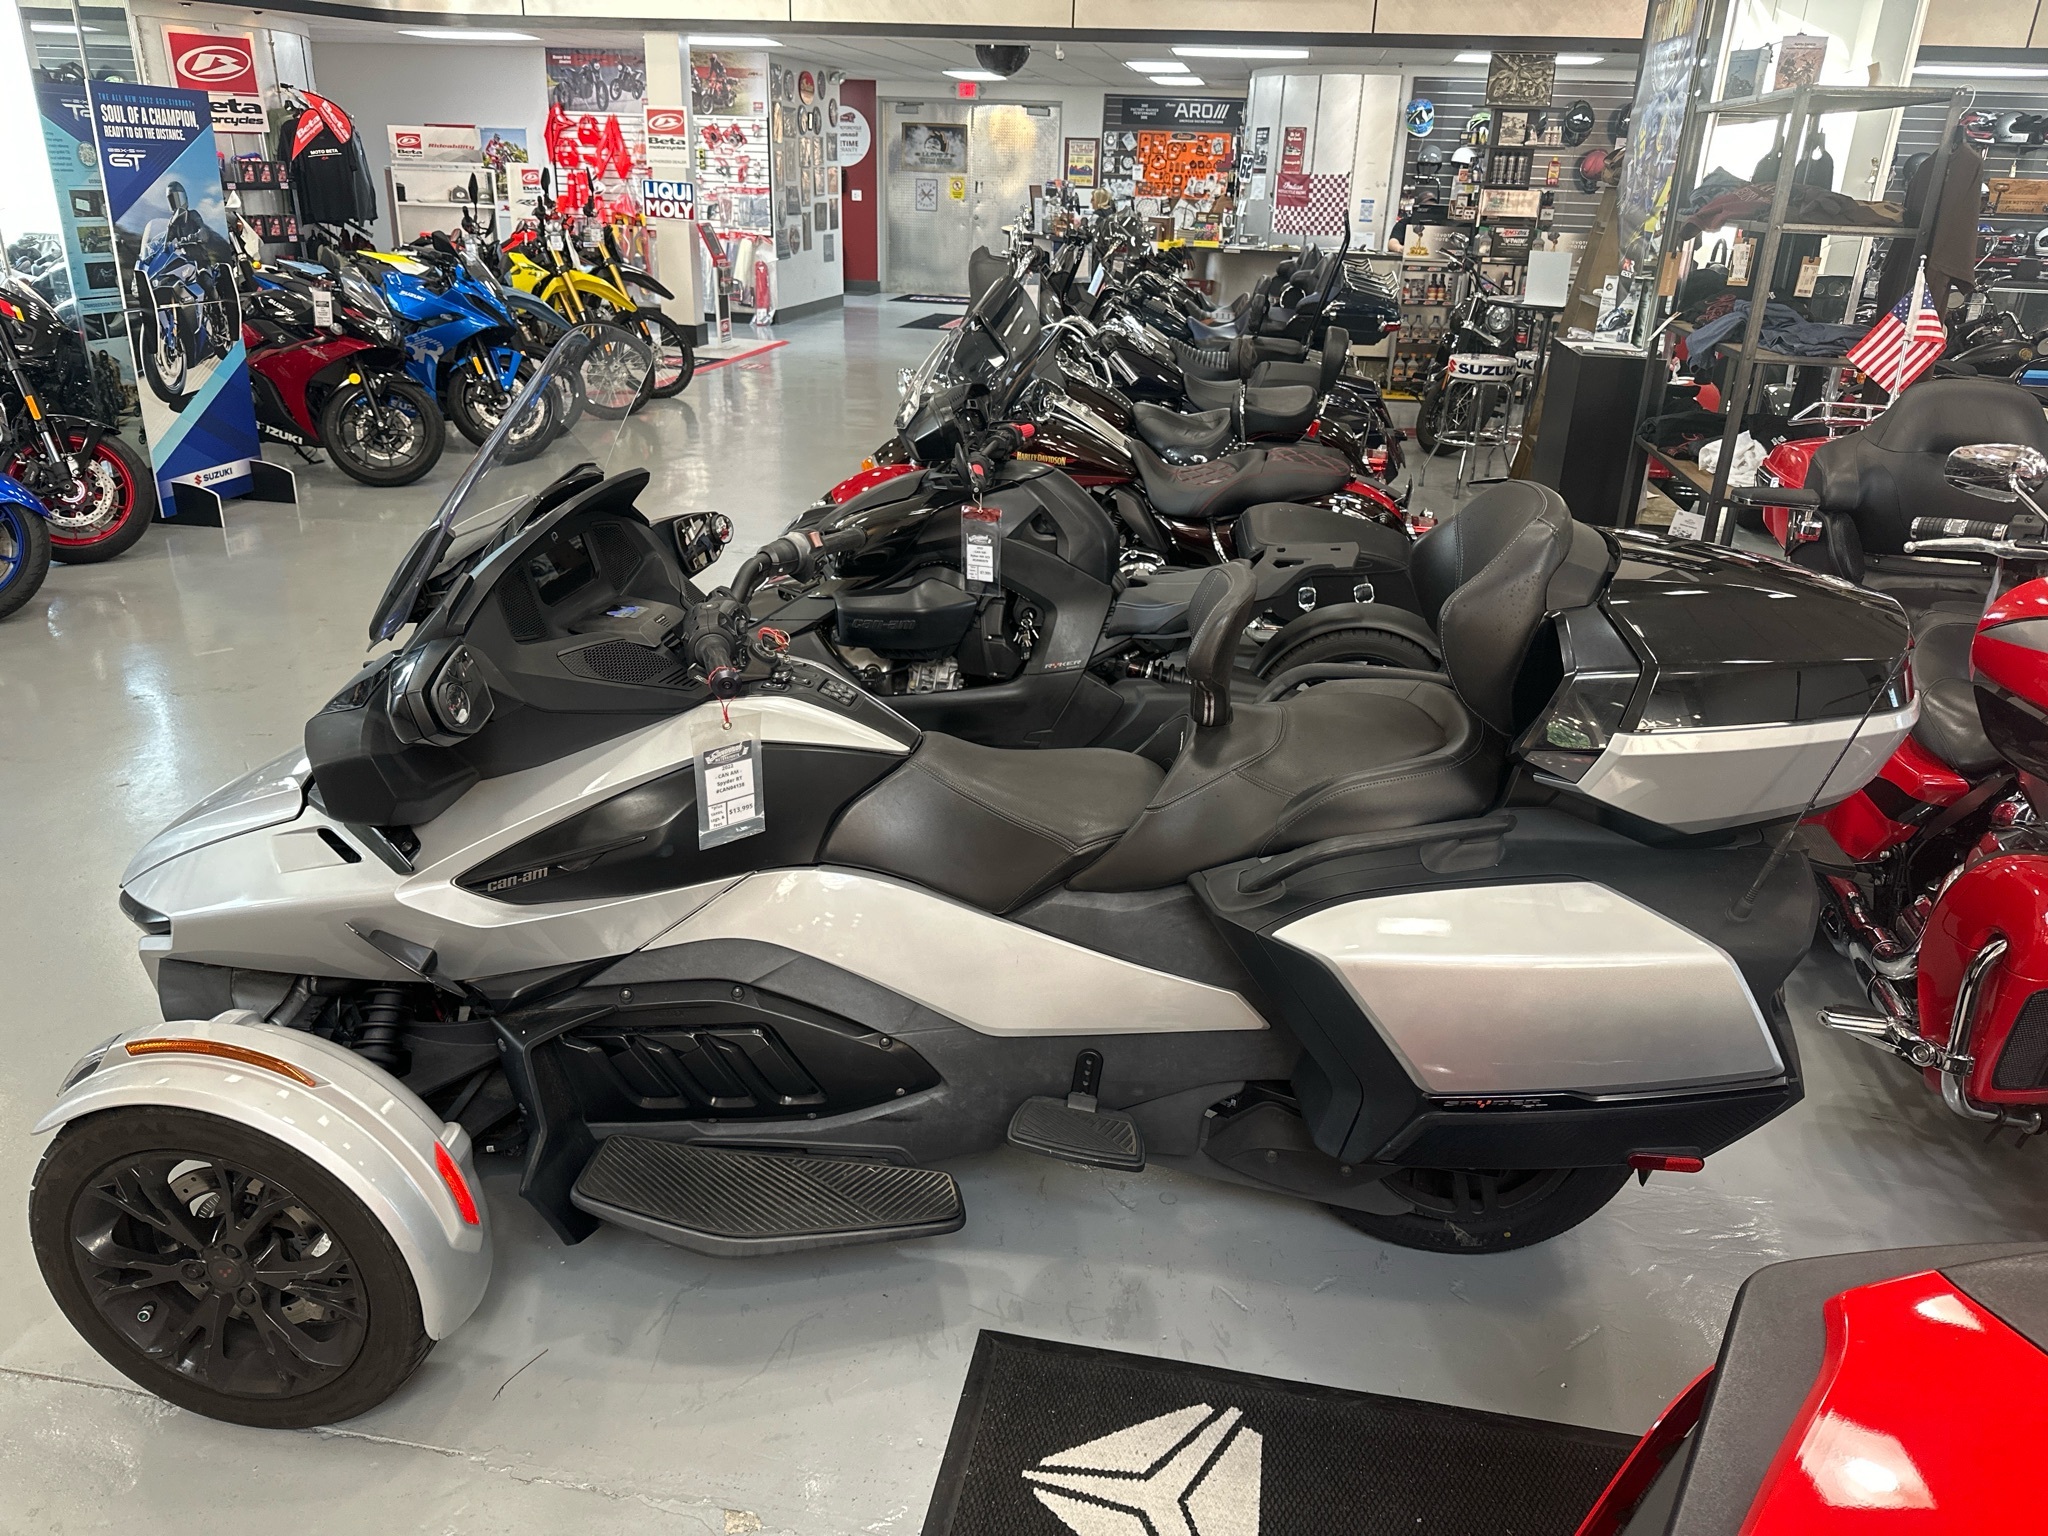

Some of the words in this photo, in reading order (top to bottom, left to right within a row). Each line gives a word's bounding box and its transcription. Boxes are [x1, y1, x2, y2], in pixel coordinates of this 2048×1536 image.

[208, 98, 263, 115] eta
[100, 103, 127, 124] SOUL
[127, 105, 140, 124] OF
[141, 107, 149, 125] A
[148, 107, 200, 130] CHAMPION,
[211, 116, 264, 126] orcycles
[103, 125, 125, 138] READY
[125, 126, 134, 138] TO
[134, 127, 143, 139] GO
[143, 128, 156, 139] THE
[156, 128, 186, 141] DISTANCE.
[296, 115, 321, 139] Beta
[648, 137, 686, 145] Beta
[109, 153, 147, 172] GT
[1240, 156, 1254, 179] 62
[644, 181, 692, 199] LIQUI
[645, 201, 694, 219] MOLY
[399, 290, 426, 301] SUZUKI
[268, 298, 294, 315] SUZUKI
[1016, 451, 1066, 466] HARLEY-DAVIDSON
[203, 467, 233, 482] SUZUKI
[852, 617, 917, 631] can-am
[730, 769, 739, 777] AM
[717, 777, 735, 788] Spyder
[728, 803, 753, 816] $13,995
[487, 866, 549, 892] can-am
